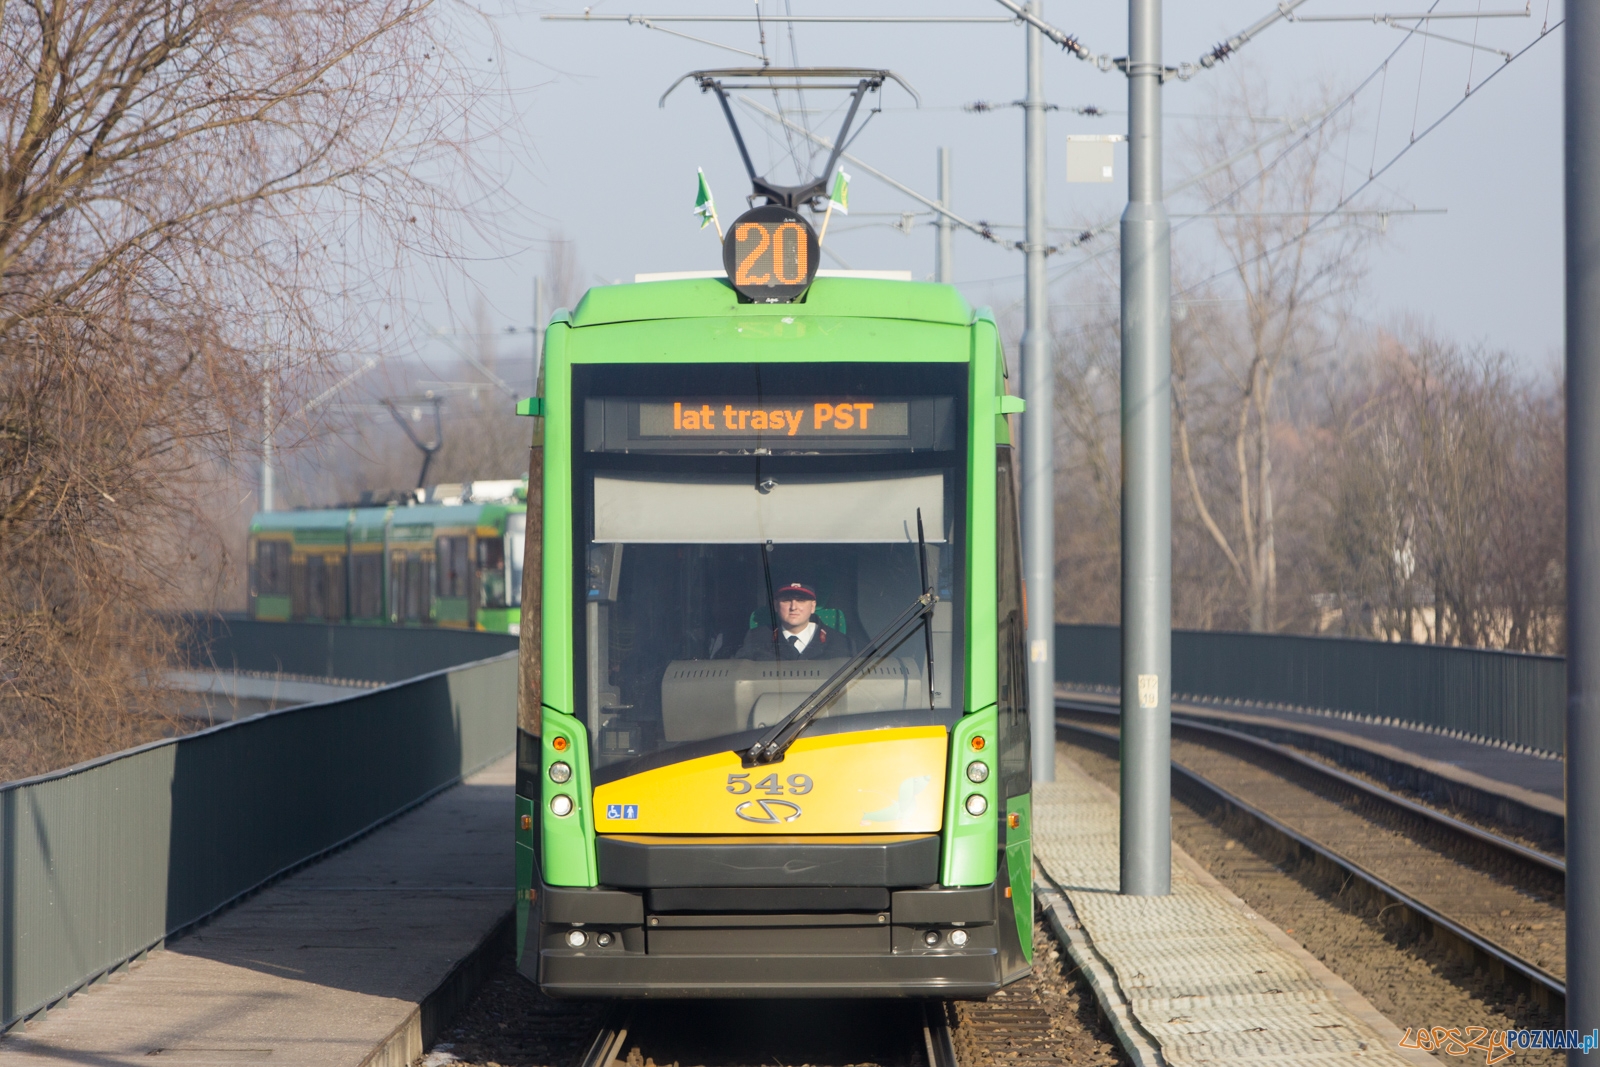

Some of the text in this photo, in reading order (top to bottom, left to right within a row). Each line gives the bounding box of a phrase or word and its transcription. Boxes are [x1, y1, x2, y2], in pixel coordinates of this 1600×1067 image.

[735, 222, 808, 285] 20
[673, 402, 874, 436] lat trasy PST
[725, 773, 814, 795] 549
